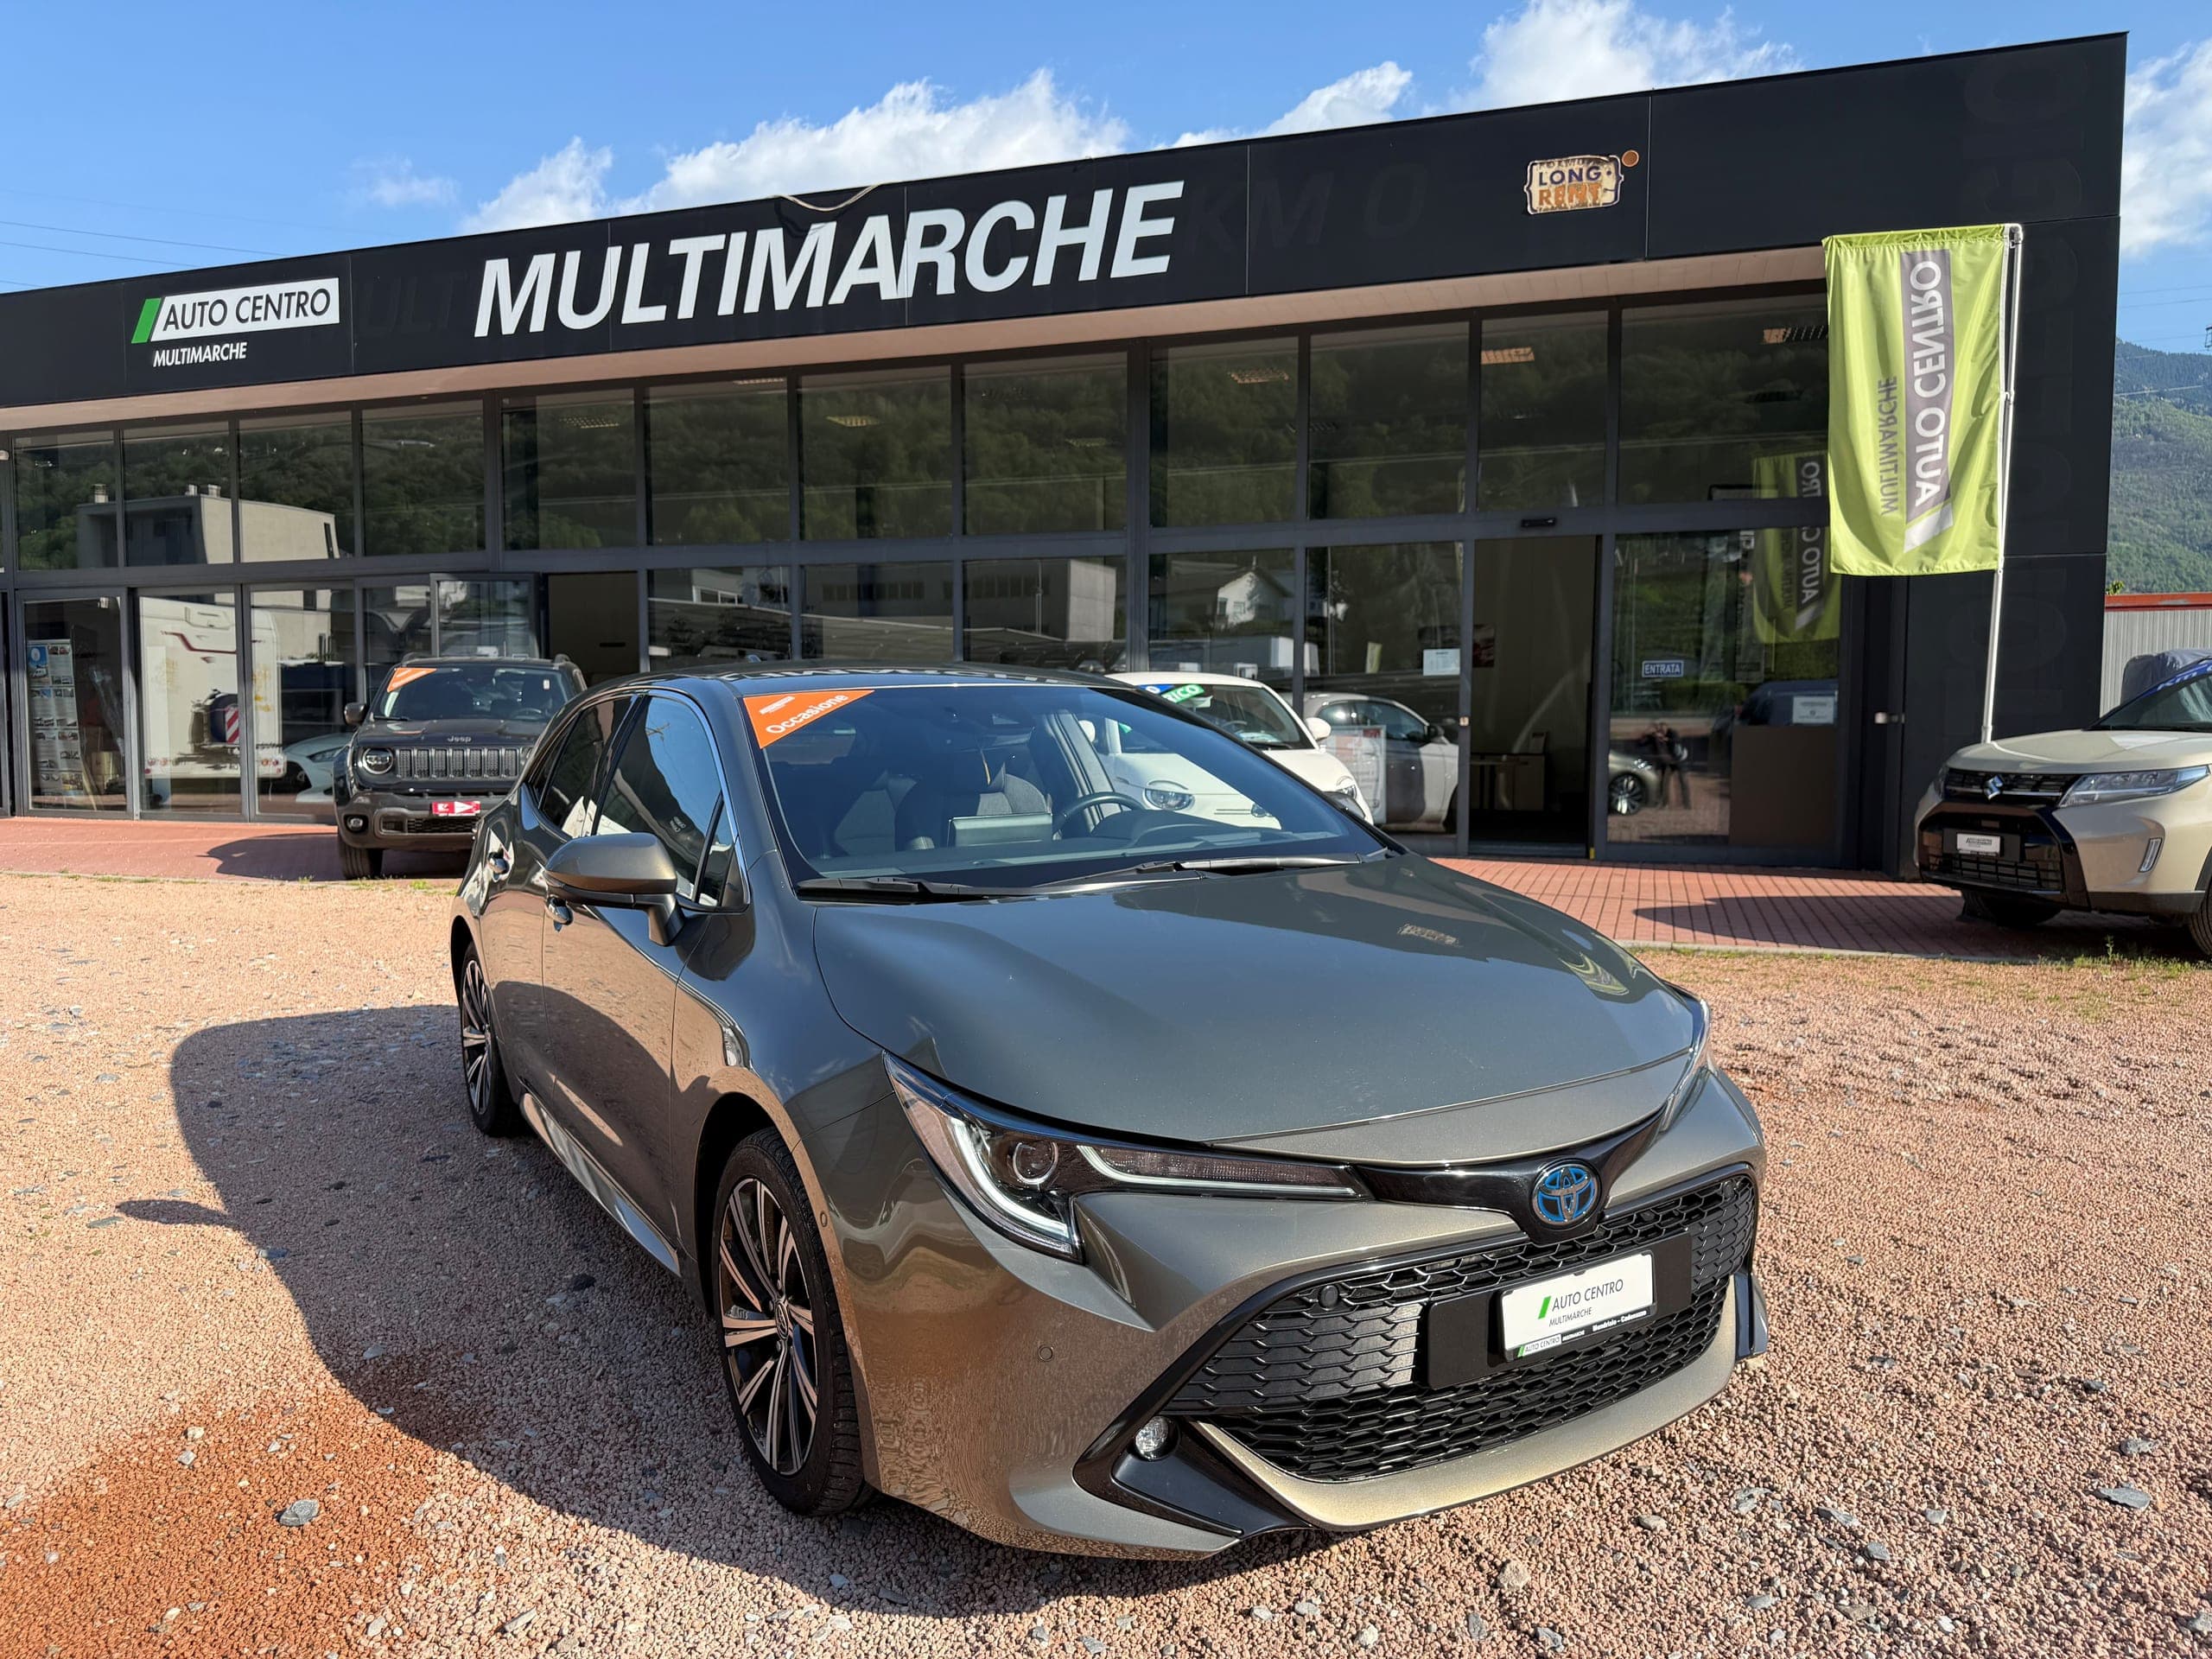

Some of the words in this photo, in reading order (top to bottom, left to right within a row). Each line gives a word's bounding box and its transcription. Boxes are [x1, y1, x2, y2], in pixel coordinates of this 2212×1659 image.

[1538, 166, 1602, 187] LONG
[474, 180, 1186, 339] MULTIMARCHE
[162, 299, 228, 332] AUTO
[235, 288, 331, 324] CENTRO
[153, 342, 248, 368] MULTIMARCHE
[1644, 664, 1681, 675] ENTRATA
[766, 695, 849, 734] Occasione
[447, 734, 472, 744] Jeep
[1552, 1291, 1581, 1312] AUTO
[1584, 1279, 1624, 1301] CENTRO
[1548, 1306, 1592, 1327] MULTIMARCHE
[1525, 1343, 1540, 1353] AUTO
[1540, 1337, 1560, 1349] CENTRO
